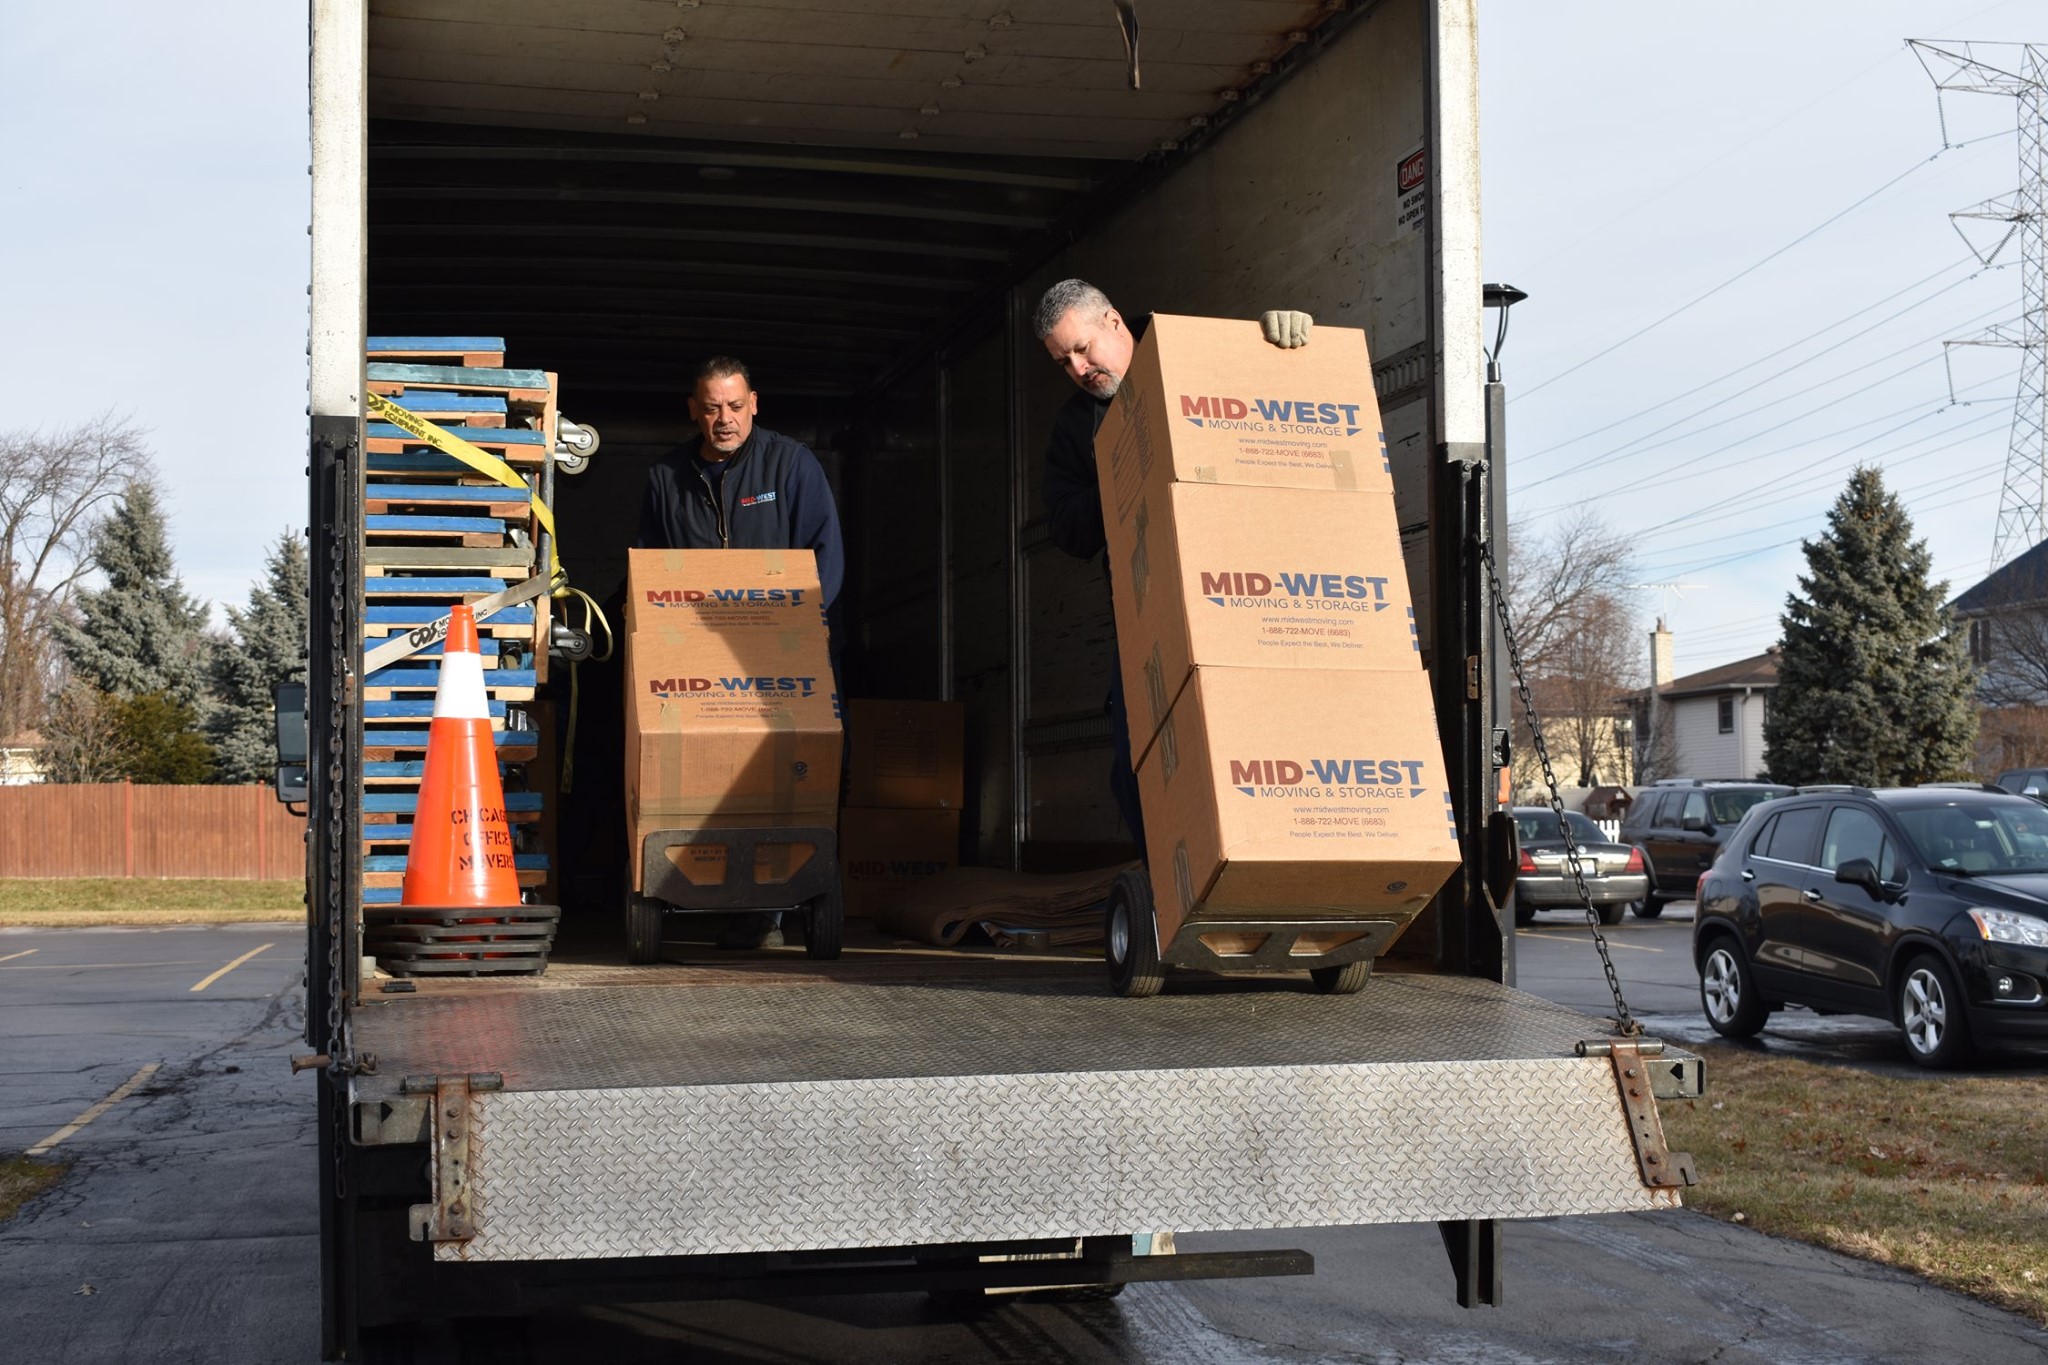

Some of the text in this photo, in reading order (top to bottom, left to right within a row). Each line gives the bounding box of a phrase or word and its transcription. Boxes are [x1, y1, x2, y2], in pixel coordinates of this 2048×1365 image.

[1406, 207, 1419, 221] OPEN
[367, 390, 388, 412] DS
[389, 404, 424, 428] MOVING
[1180, 395, 1360, 426] MID-WEST
[384, 411, 426, 441] EQUIPMENT,
[1208, 419, 1342, 437] MOVING & STORAGE
[1239, 438, 1327, 448] www.midwestmoving.com
[1200, 572, 1388, 600] MID-WEST
[646, 589, 805, 603] MID-WEST
[1230, 597, 1369, 612] MOVING & STORAGE
[1261, 616, 1354, 626] www.midwestmoving.com
[409, 622, 438, 648] CDS
[1262, 627, 1325, 636] 1-888-722-MOVE
[1281, 640, 1301, 648] Expect
[649, 677, 816, 694] MID-WEST
[1230, 759, 1424, 786] MID-WEST
[1261, 787, 1404, 799] MOVING & STORAGE
[1293, 806, 1389, 815] www.midwestmoving.com
[1293, 818, 1386, 826] 1-888-722-MOVE (6683)
[459, 854, 513, 870] MVERS
[848, 861, 947, 875] MID-WEST
